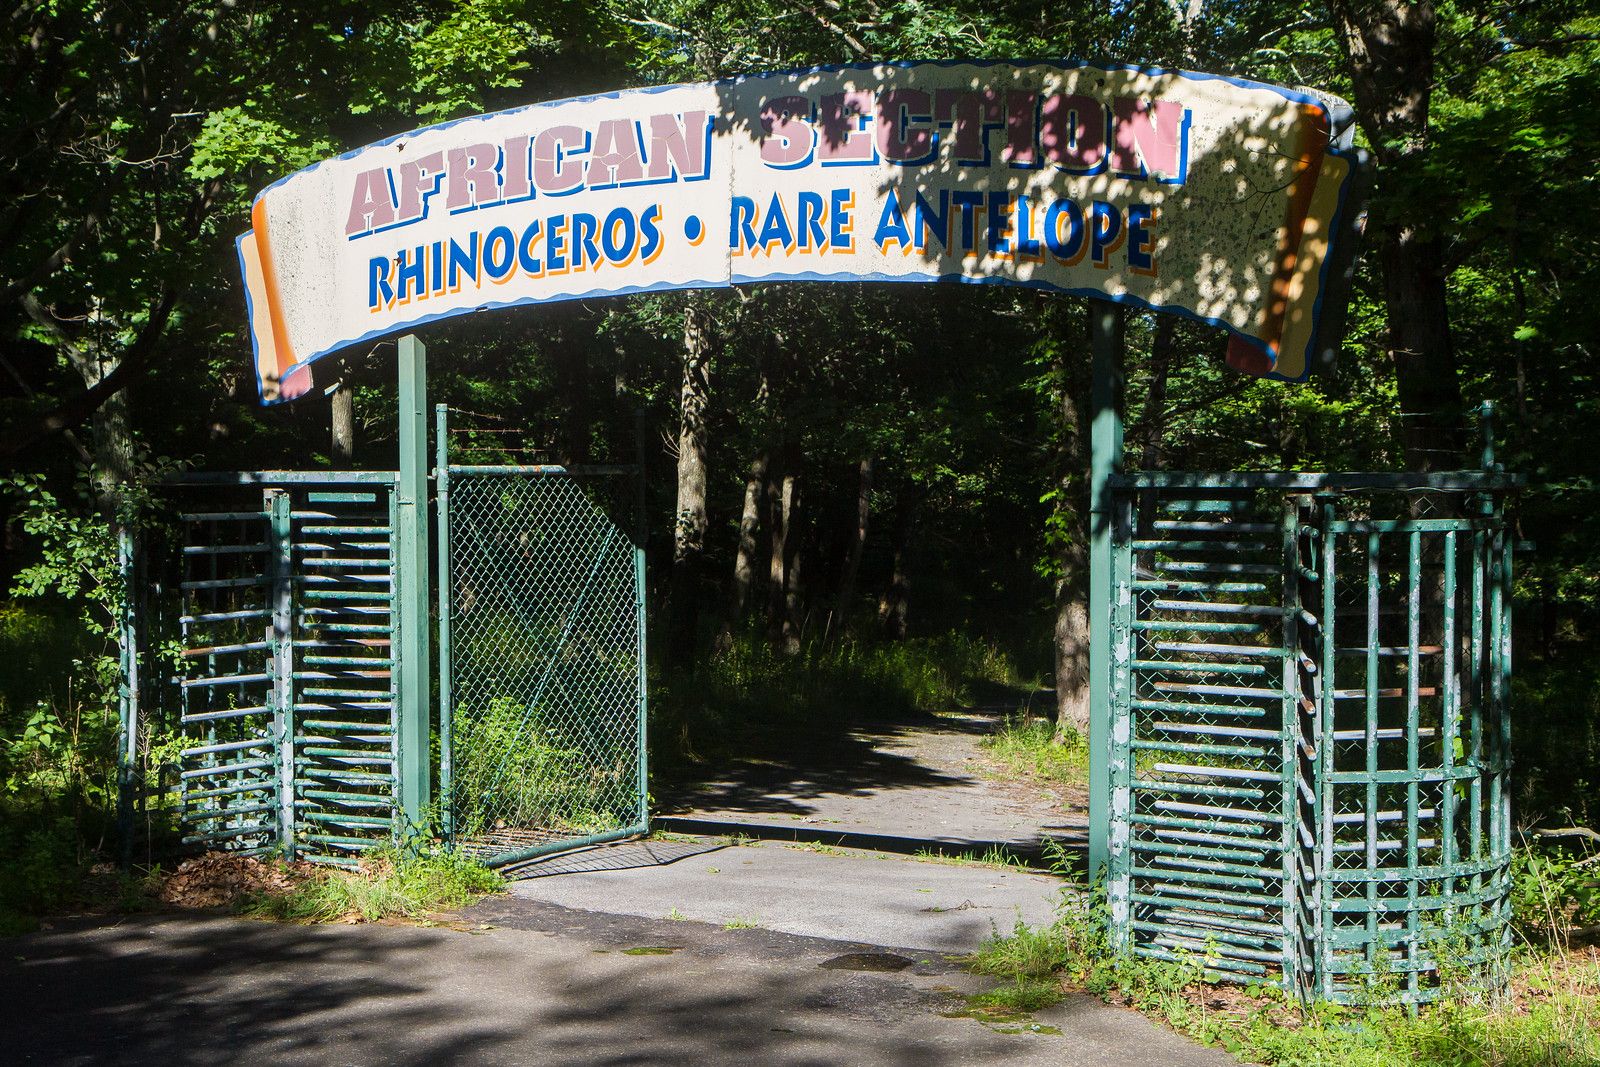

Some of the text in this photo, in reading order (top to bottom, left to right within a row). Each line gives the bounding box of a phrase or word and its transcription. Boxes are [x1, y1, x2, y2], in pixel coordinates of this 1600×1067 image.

[345, 88, 1192, 241] AFRICAN SECTION
[369, 188, 1158, 313] RHINOCEROS RARE ANTELOPE
